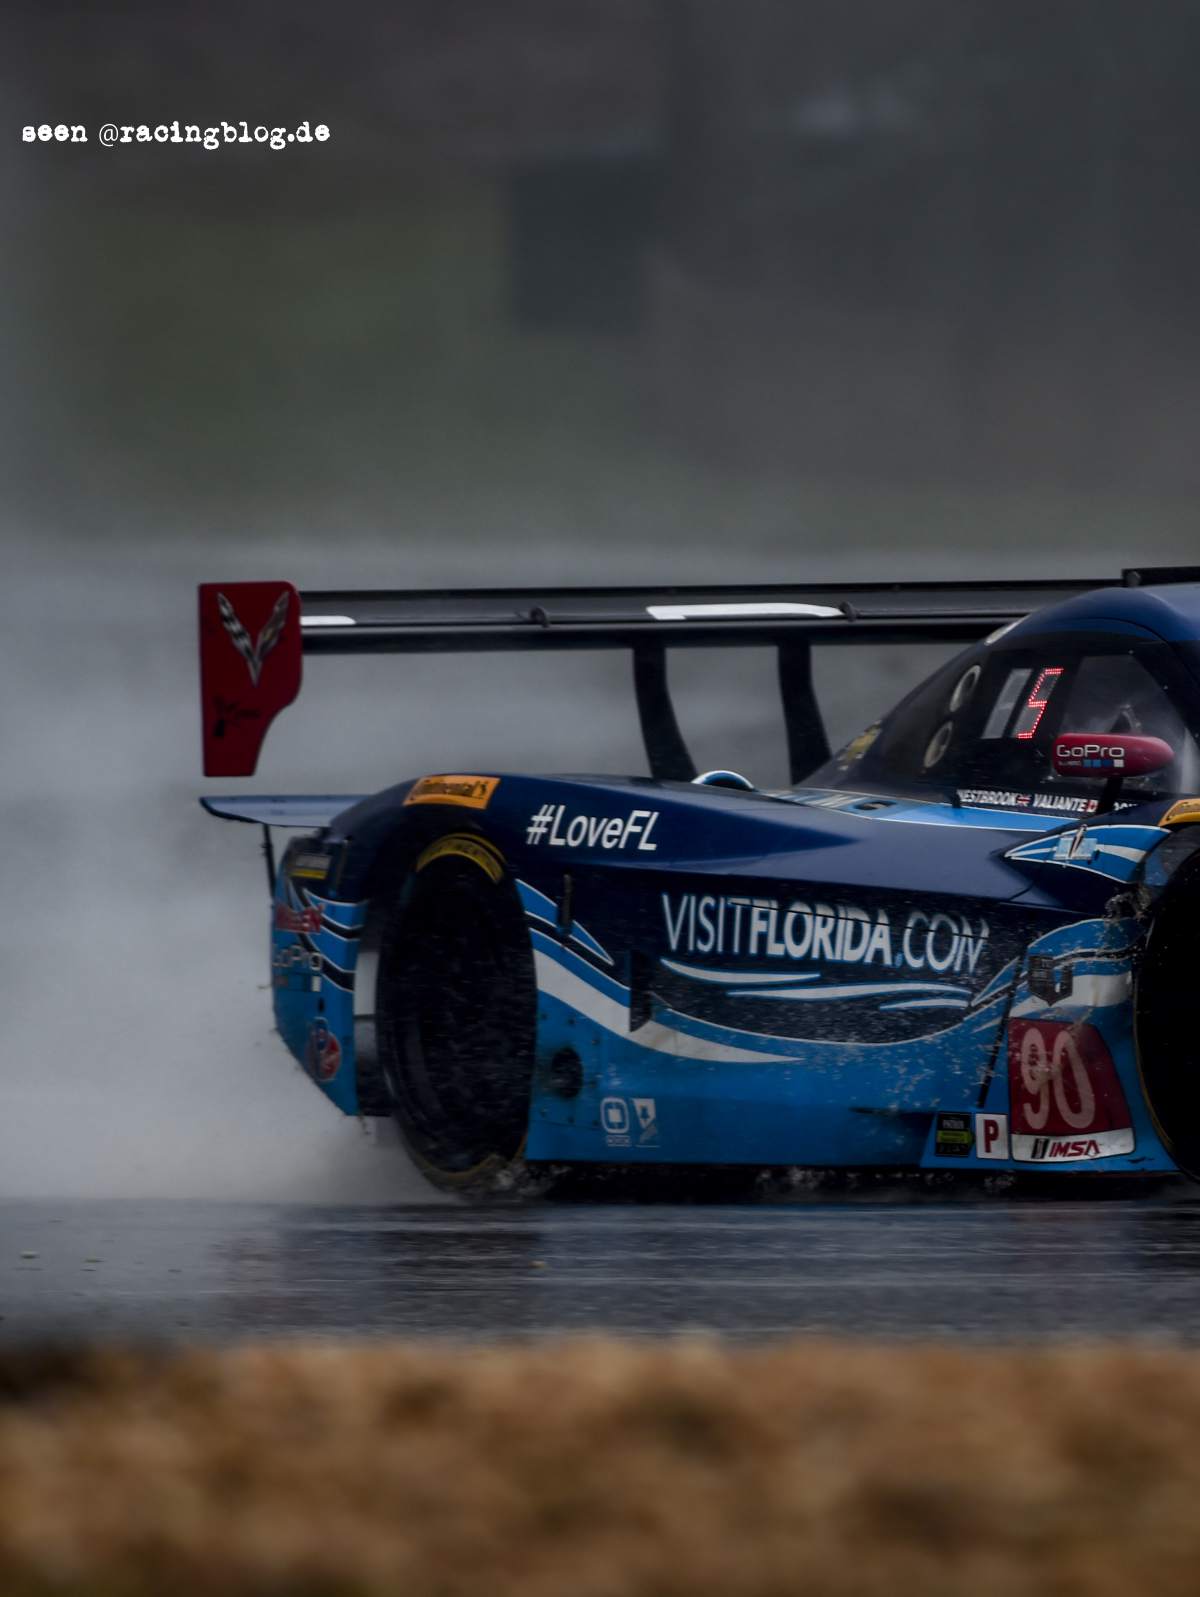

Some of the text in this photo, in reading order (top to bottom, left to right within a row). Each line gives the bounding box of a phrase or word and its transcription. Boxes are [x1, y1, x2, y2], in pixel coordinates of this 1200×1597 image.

[1056, 744, 1126, 758] GoPro
[1032, 793, 1088, 812] VALIANTE
[526, 803, 660, 851] #LoveFL
[662, 892, 990, 975] VISITFLORIDA.COM
[1020, 1027, 1096, 1130] 90
[984, 1119, 1000, 1153] P
[1049, 1139, 1101, 1158] IMSA
